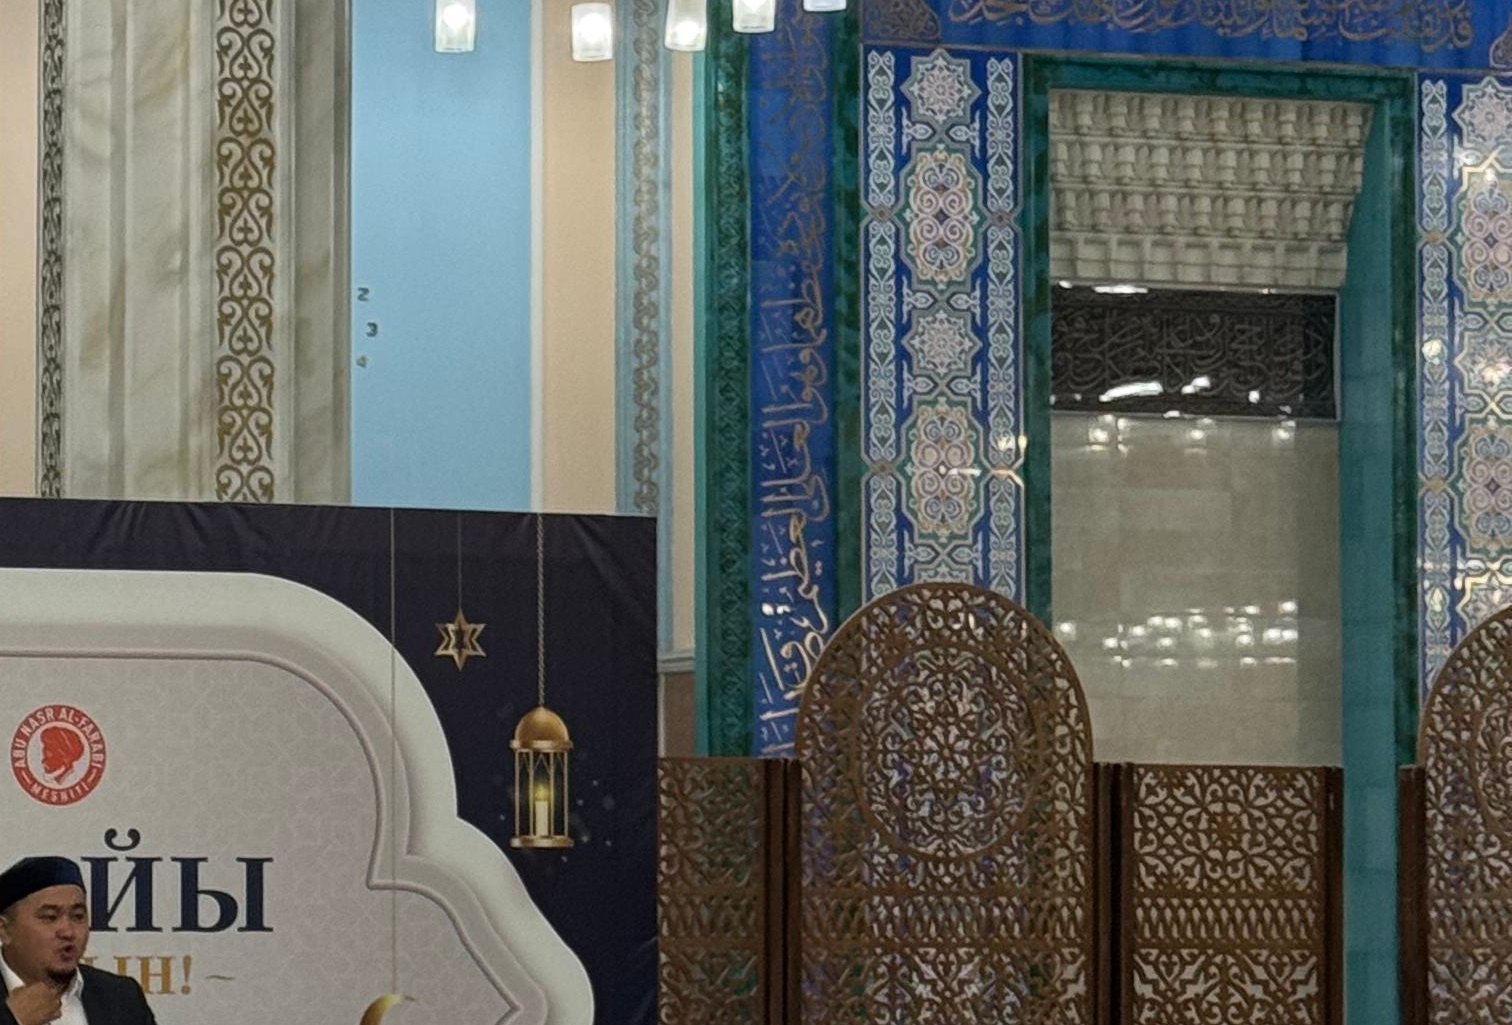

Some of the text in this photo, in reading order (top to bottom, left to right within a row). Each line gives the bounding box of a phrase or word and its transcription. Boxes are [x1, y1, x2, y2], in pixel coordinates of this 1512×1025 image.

[357, 287, 369, 301] 2
[366, 322, 378, 337] 3
[12, 707, 105, 768] ABU NASR AL-FARABI
[80, 828, 274, 933] ЙЫ
